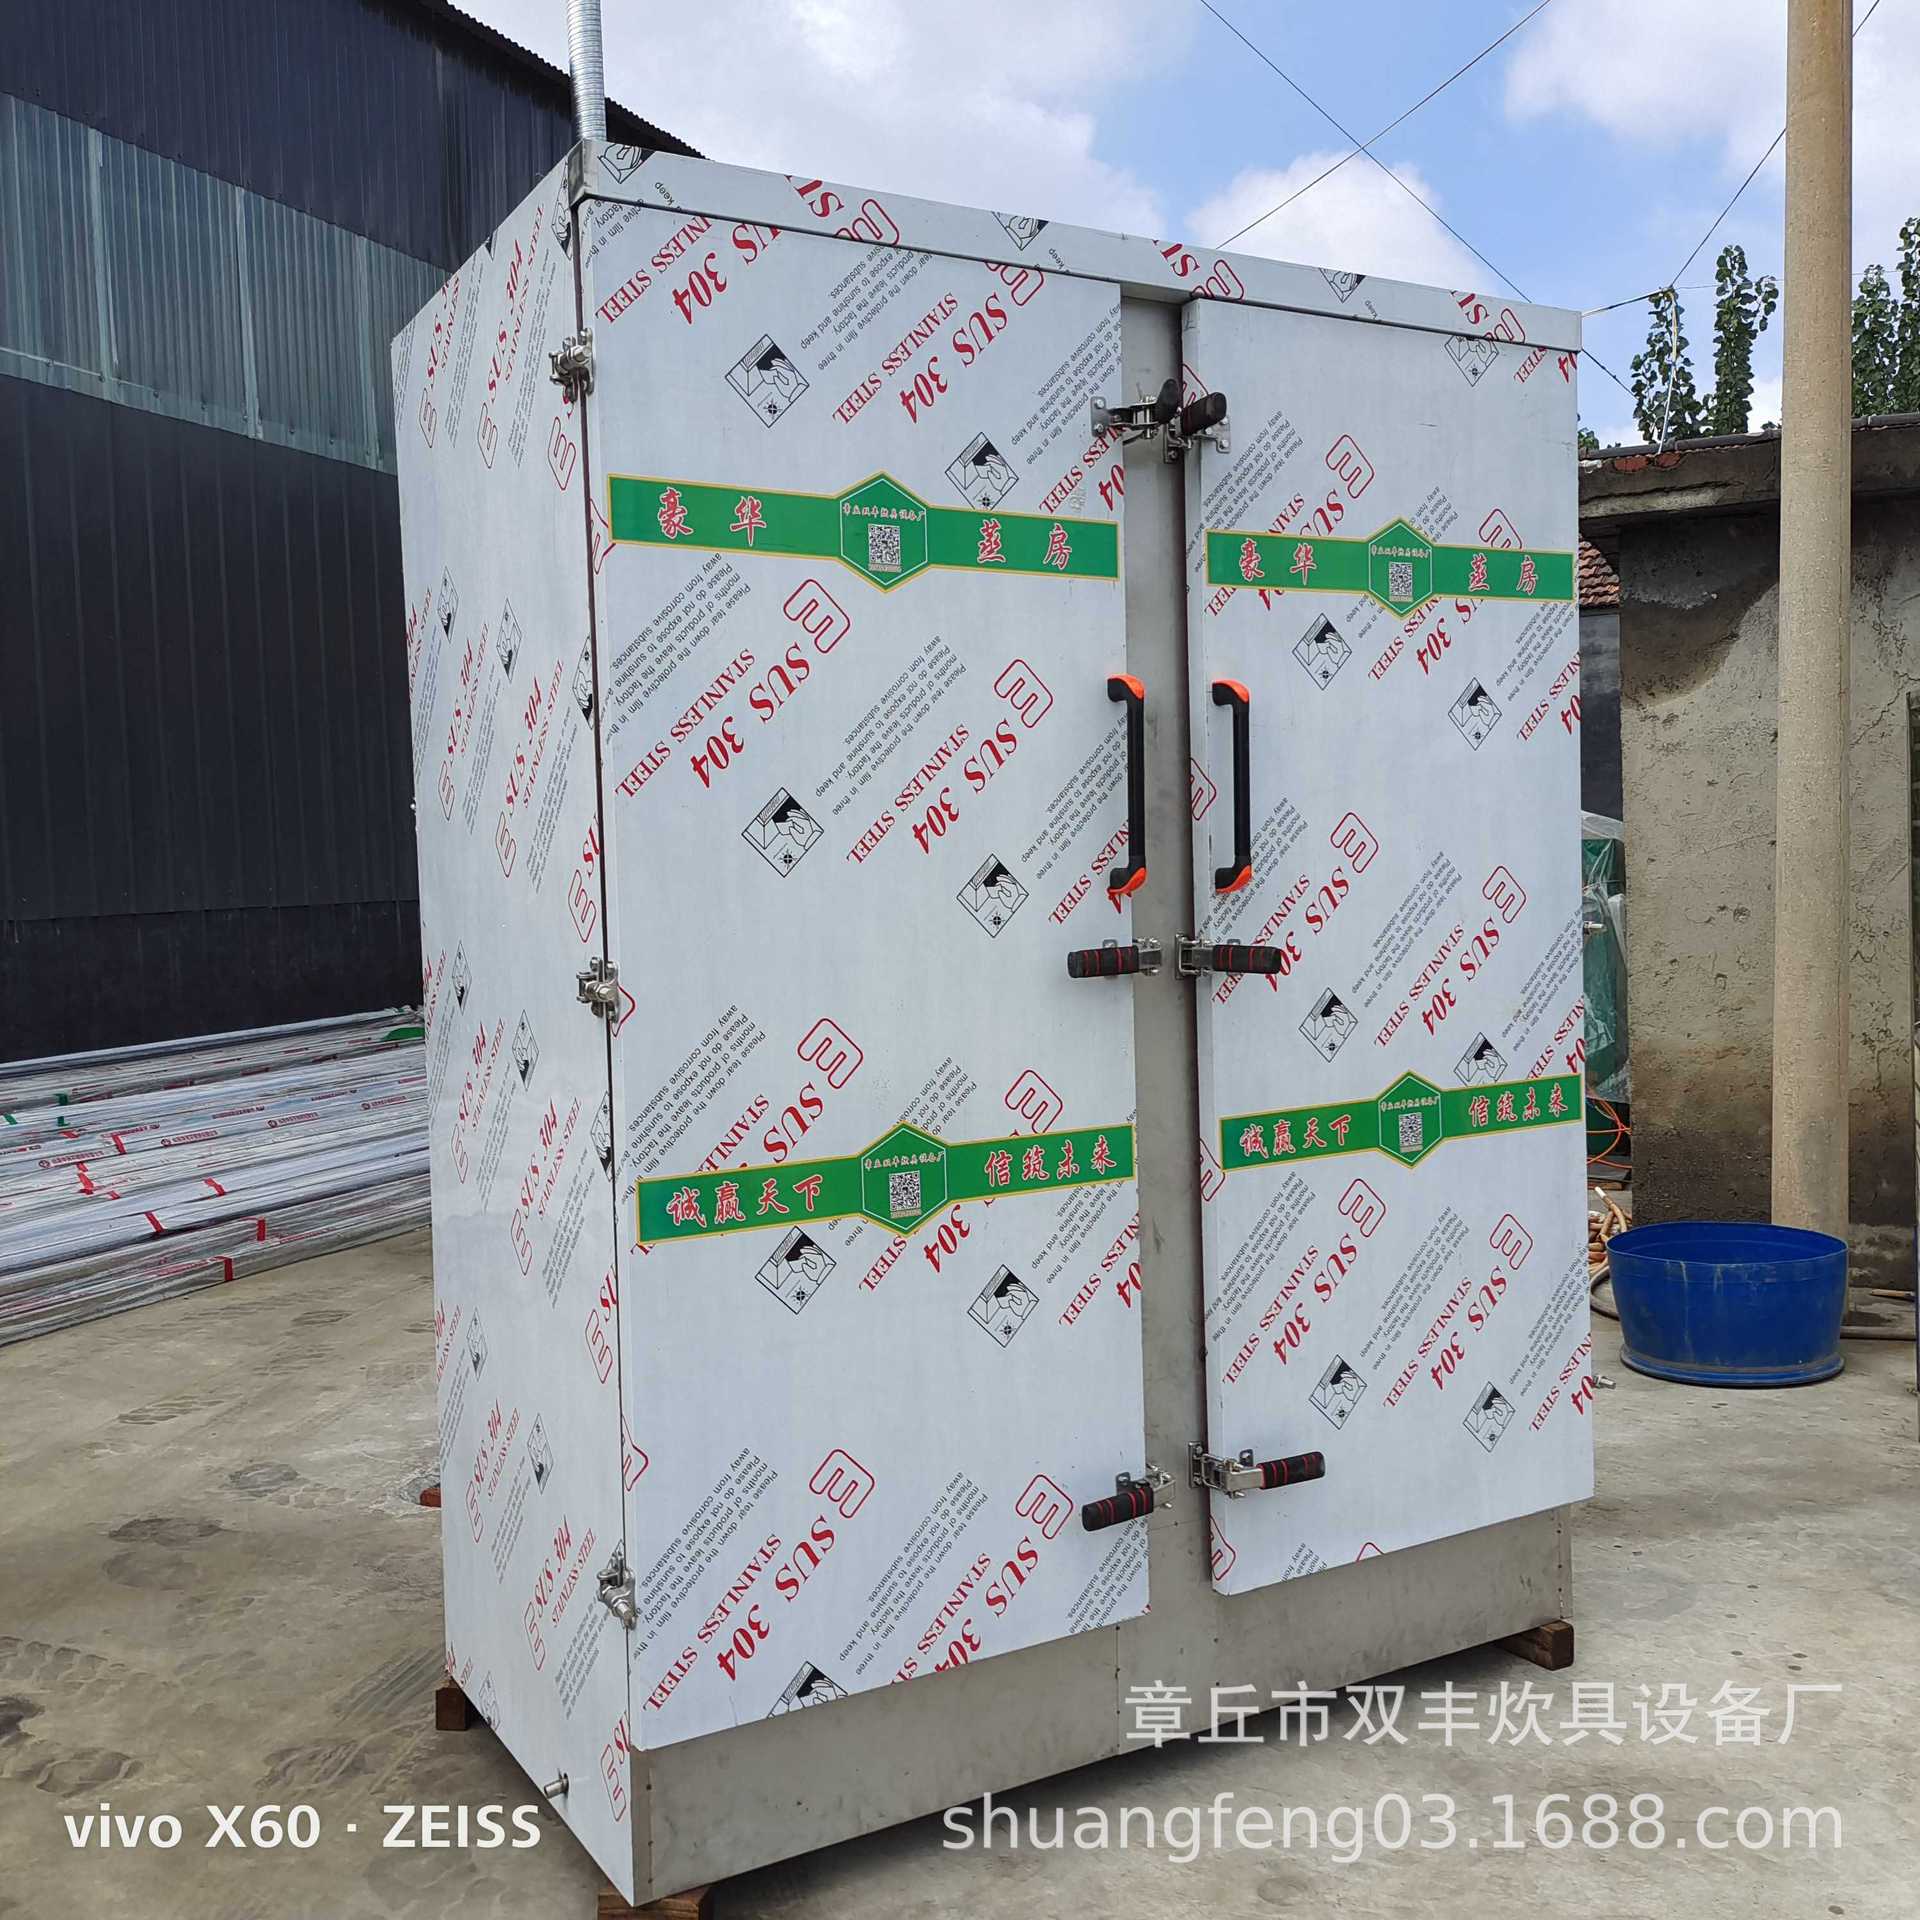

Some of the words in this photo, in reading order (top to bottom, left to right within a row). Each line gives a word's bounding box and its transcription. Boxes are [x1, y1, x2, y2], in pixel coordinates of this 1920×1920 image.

[595, 269, 652, 323] STEEL
[672, 252, 727, 324] 304
[487, 320, 508, 404] SUS
[506, 239, 523, 316] 304
[881, 293, 958, 376] STAINLESS
[952, 293, 1008, 366] SUS
[832, 372, 882, 423] STEEL
[899, 356, 948, 423] 304
[1039, 465, 1083, 521] STEEL
[657, 488, 767, 546] 豪华
[976, 518, 1073, 571] 蒸房
[1238, 538, 1319, 585] 豪华
[1467, 554, 1541, 596] 蒸房
[907, 655, 926, 673] from
[923, 635, 942, 656] away
[927, 644, 951, 670] Please
[933, 653, 958, 681] months
[1367, 636, 1404, 680] STEEL
[1416, 618, 1451, 673] 304
[670, 649, 755, 743] STAINLESS
[749, 642, 810, 723] SUS
[880, 672, 909, 705] corrosive
[906, 680, 918, 695] not
[917, 669, 928, 681] do
[926, 680, 935, 691] of
[930, 687, 945, 704] tear
[943, 663, 967, 688] Please
[844, 704, 881, 745] substances.
[874, 719, 885, 730] to
[881, 719, 902, 740] leave
[883, 693, 907, 720] expose
[899, 687, 927, 720] products
[901, 723, 914, 737] the
[912, 703, 931, 724] down
[1516, 699, 1550, 741] STEEL
[505, 743, 526, 818] SUS
[524, 676, 542, 746] 304
[522, 716, 549, 809] STAINLESS
[547, 659, 564, 716] STEEL
[690, 716, 744, 788] 304
[846, 729, 875, 762] sunshine
[869, 740, 883, 754] the
[870, 734, 902, 771] protective
[963, 719, 1017, 793] SUS
[615, 741, 671, 797] STEEL
[815, 777, 835, 798] keep
[831, 761, 846, 780] and
[847, 753, 872, 780] factory.
[849, 785, 860, 796] in
[857, 771, 873, 786] film
[894, 724, 969, 812] STAINLESS
[831, 795, 852, 816] three
[912, 787, 960, 854] 304
[846, 810, 895, 863] STEEL
[1048, 874, 1092, 924] STEEL
[1305, 866, 1349, 935] SUS
[1409, 924, 1464, 1001] STAINLESS
[1459, 917, 1500, 982] SUS
[1374, 1001, 1410, 1046] STEEL
[1422, 978, 1457, 1036] 304
[763, 1083, 825, 1167] SUS
[1239, 1115, 1351, 1156] 诚赢天下
[1468, 1084, 1570, 1124] 信筑未来
[666, 1174, 824, 1227] 诚赢天下
[984, 1136, 1117, 1184] 信筑未来
[859, 1230, 904, 1291] STEEL
[923, 1204, 971, 1273] 304
[1259, 1245, 1318, 1331] STAINLESS
[1314, 1233, 1357, 1303] SUS
[1058, 1273, 1102, 1325] STEEL
[1417, 1277, 1472, 1358] STAINLESS
[1467, 1265, 1507, 1332] SUS
[1222, 1333, 1260, 1384] STEEL
[1273, 1302, 1311, 1365] 304
[1430, 1331, 1465, 1390] 304
[1383, 1359, 1419, 1407] STEEL
[1529, 1385, 1560, 1431] STEEL
[775, 1515, 835, 1602] SUS
[985, 1536, 1039, 1617] SUS
[697, 1534, 781, 1643] STAINLESS
[917, 1553, 991, 1655] STAINLESS
[717, 1604, 770, 1681] 304
[643, 1646, 698, 1710] STEEL
